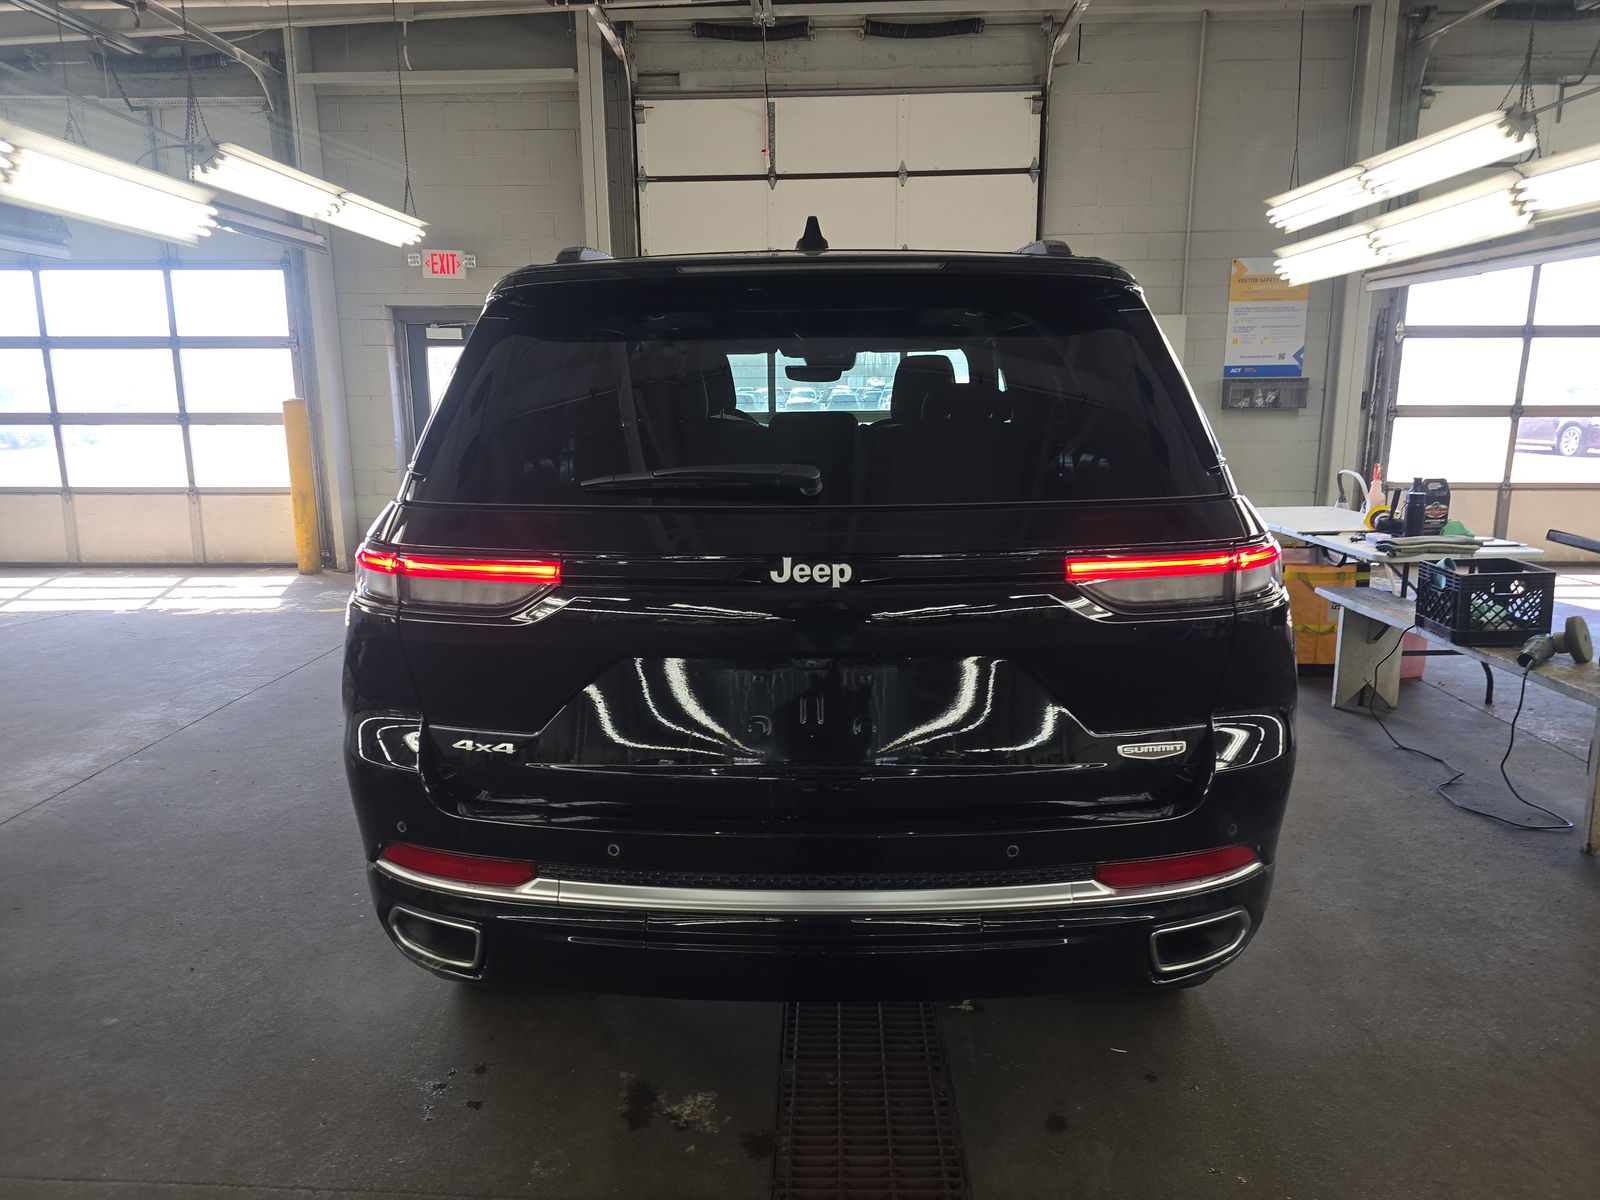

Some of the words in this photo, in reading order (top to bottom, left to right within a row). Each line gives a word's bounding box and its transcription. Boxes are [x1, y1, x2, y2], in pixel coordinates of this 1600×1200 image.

[431, 253, 457, 274] EXIT
[770, 557, 852, 588] Jeep
[452, 740, 517, 754] 4x4
[1123, 744, 1183, 754] SUMMIT
